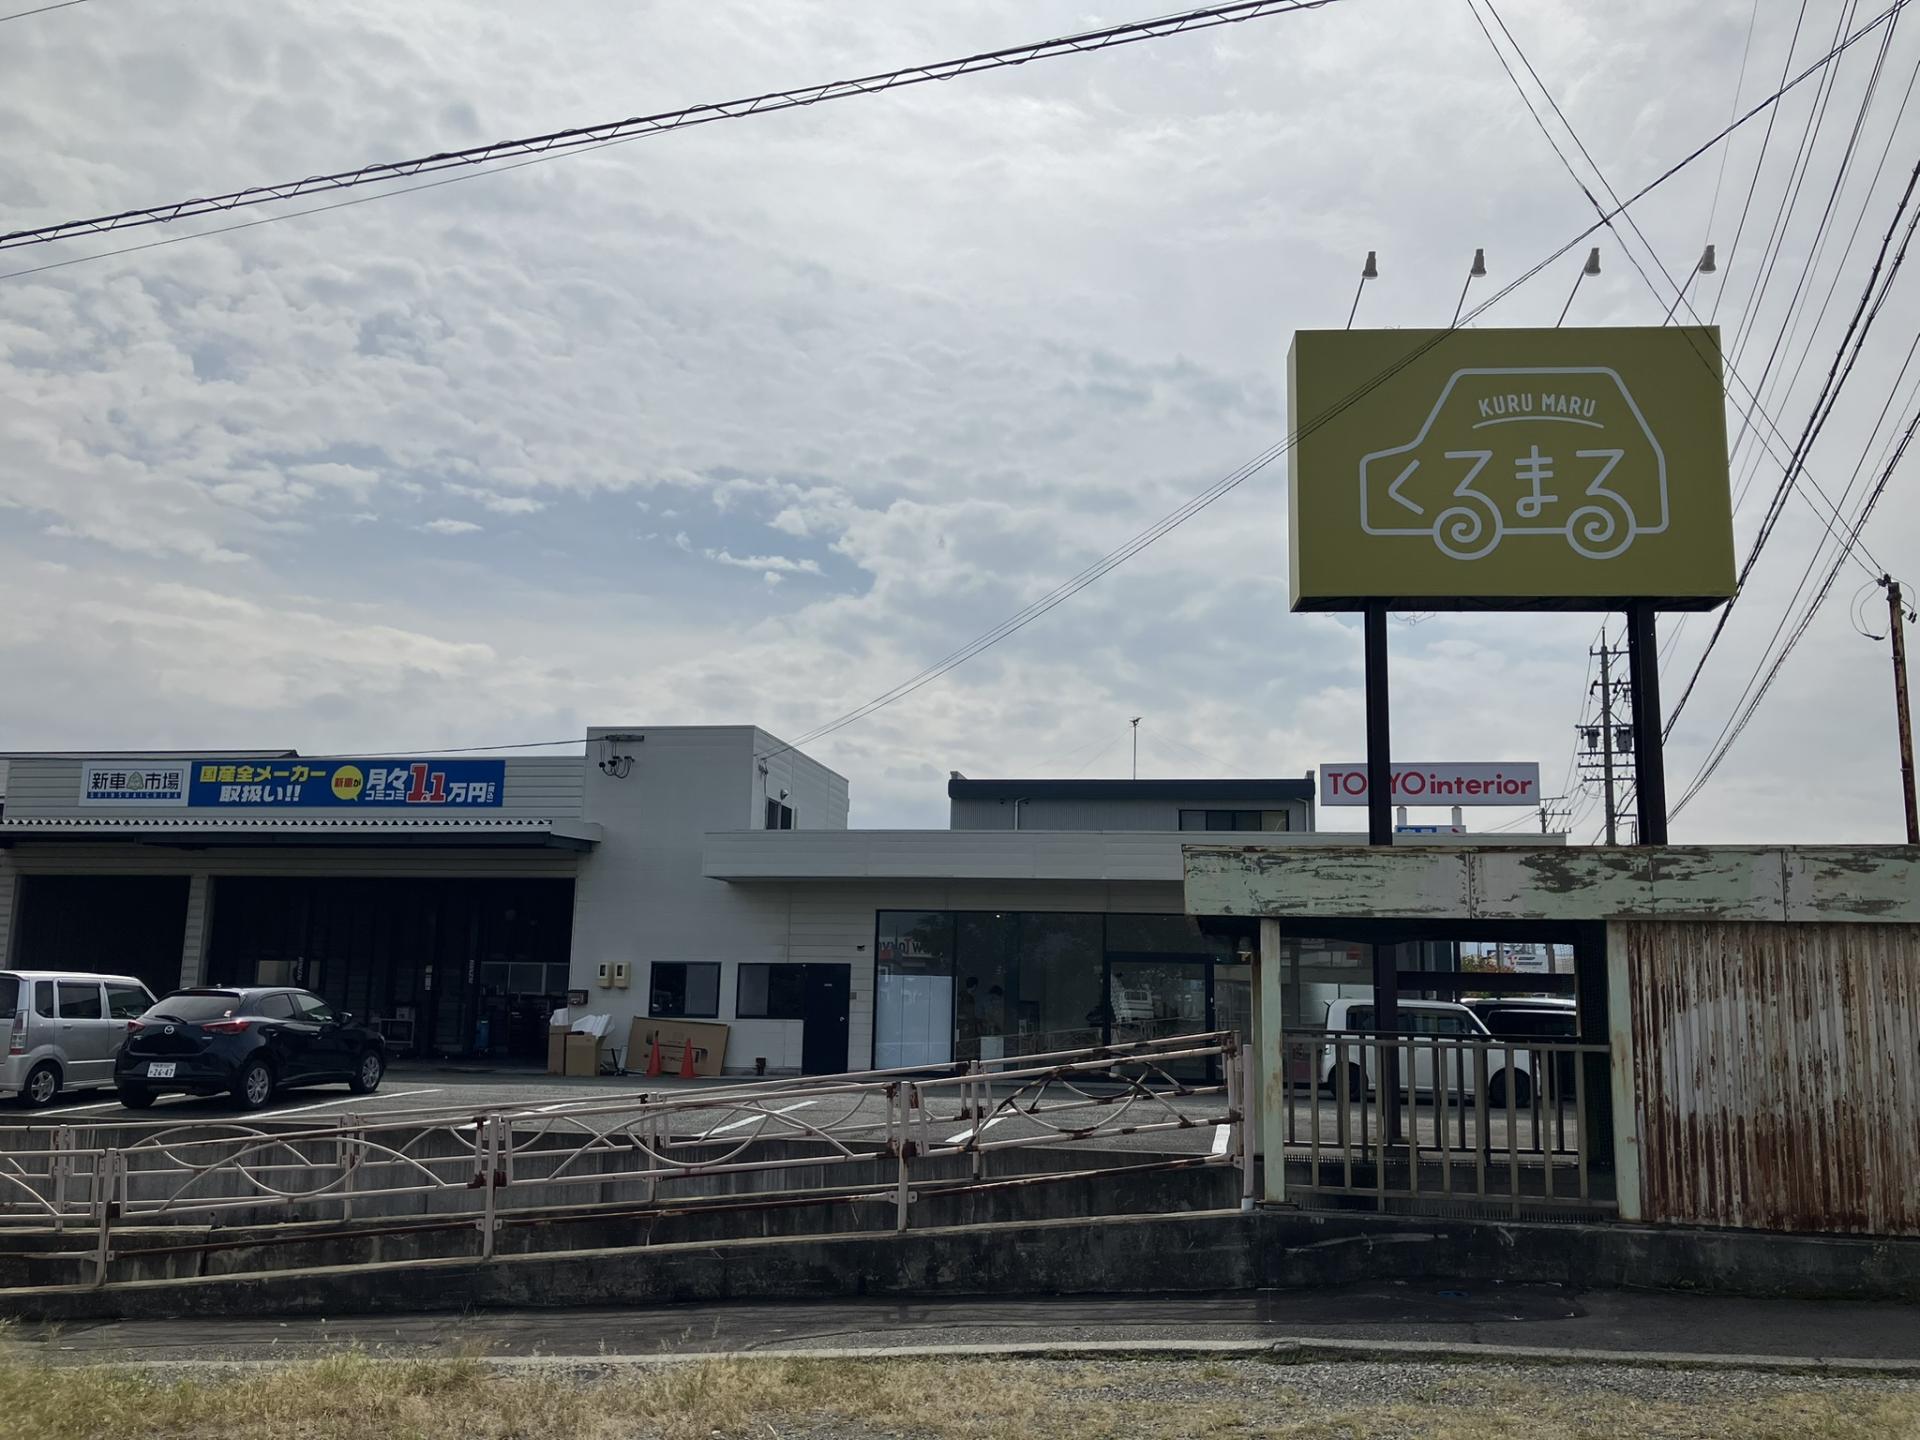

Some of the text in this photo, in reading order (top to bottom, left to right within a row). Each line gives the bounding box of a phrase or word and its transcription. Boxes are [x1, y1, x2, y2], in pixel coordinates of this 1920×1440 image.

[1477, 393, 1597, 418] KURU MARU
[1387, 444, 1638, 561] くるまる
[199, 765, 327, 783] 国産全メーカー
[366, 767, 409, 790] 月々
[1328, 771, 1533, 795] TOYO interior
[219, 784, 303, 802] 取扱い!!
[365, 790, 405, 801] コミコミ
